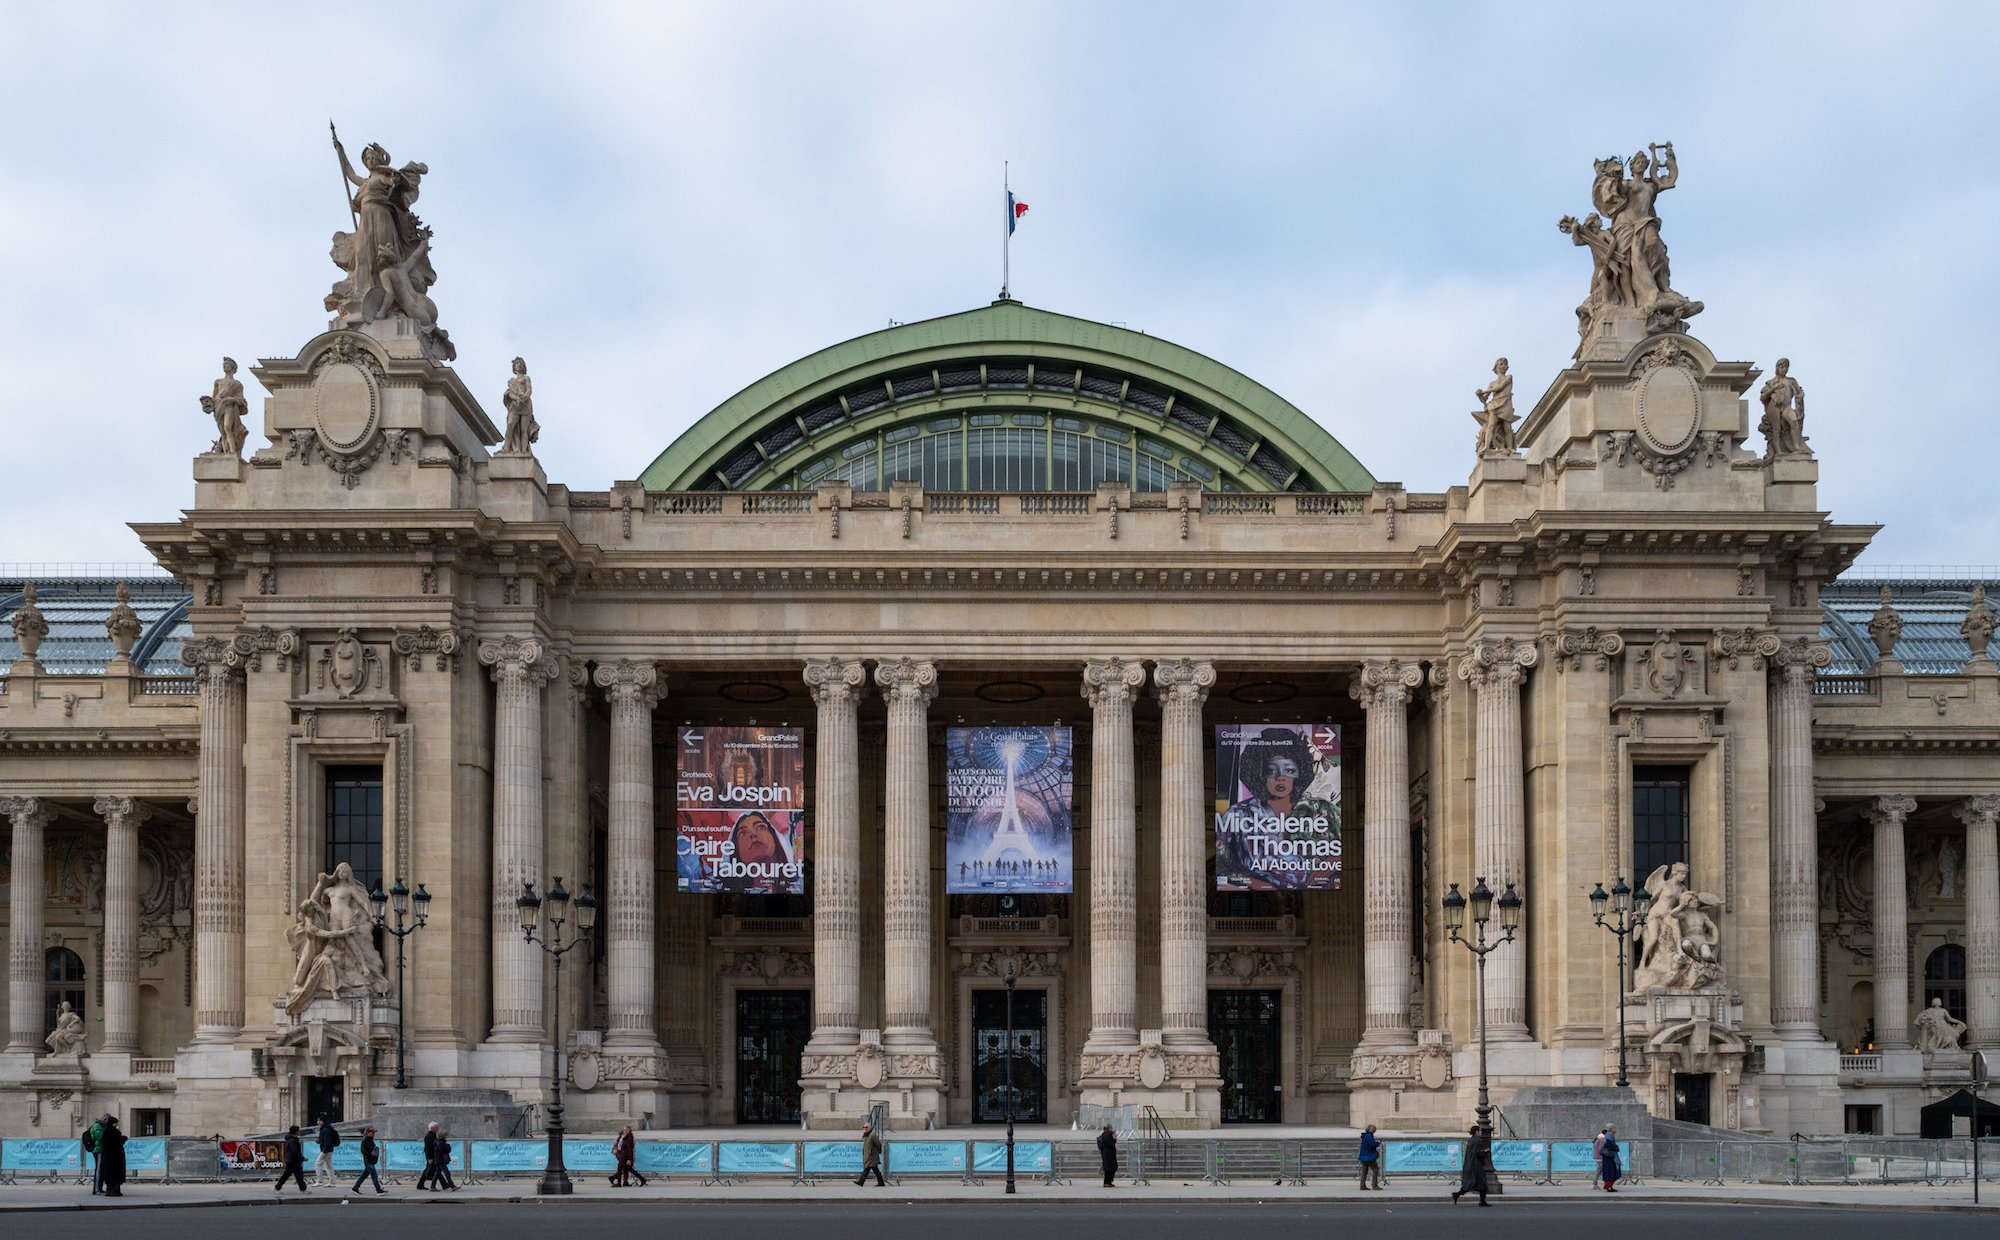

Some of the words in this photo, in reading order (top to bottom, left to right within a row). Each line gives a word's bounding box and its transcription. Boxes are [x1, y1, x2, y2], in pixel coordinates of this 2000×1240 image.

[990, 732, 1038, 740] GrandPalais
[949, 776, 1005, 784] PATINOIRE
[677, 782, 713, 802] Eva
[718, 782, 791, 806] Jospin
[948, 786, 1005, 796] INDOOR
[948, 798, 961, 806] DU
[966, 798, 1005, 806] MONDE
[1216, 813, 1328, 832] Mickalene
[677, 836, 735, 855] Claire
[1247, 836, 1341, 856] Thomas
[707, 858, 804, 878] Tabouret
[1250, 859, 1267, 871] All
[1269, 859, 1311, 871] About
[1312, 859, 1341, 871] Love
